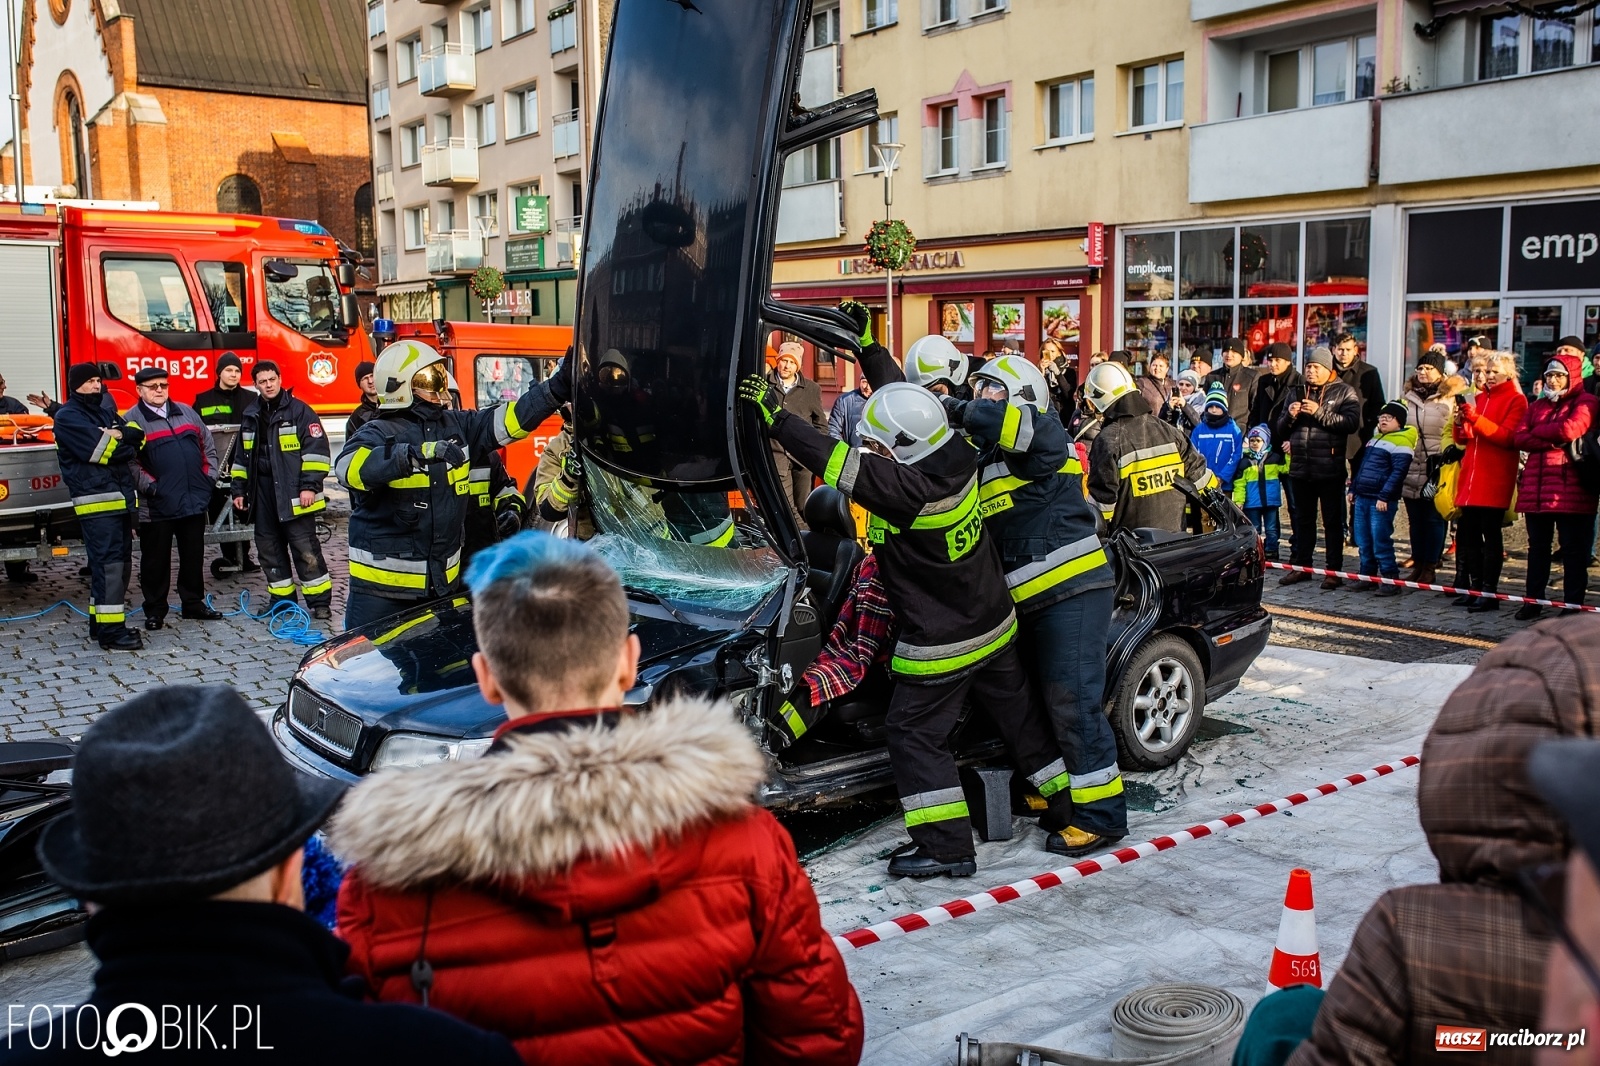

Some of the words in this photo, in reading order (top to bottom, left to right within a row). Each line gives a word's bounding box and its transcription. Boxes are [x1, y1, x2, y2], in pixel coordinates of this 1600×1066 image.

[1094, 225, 1102, 262] ŻYWIEC
[1127, 260, 1173, 276] empik.com
[182, 356, 208, 379] 32
[533, 436, 557, 458] 5
[31, 474, 61, 490] OSP
[1291, 960, 1316, 977] 569
